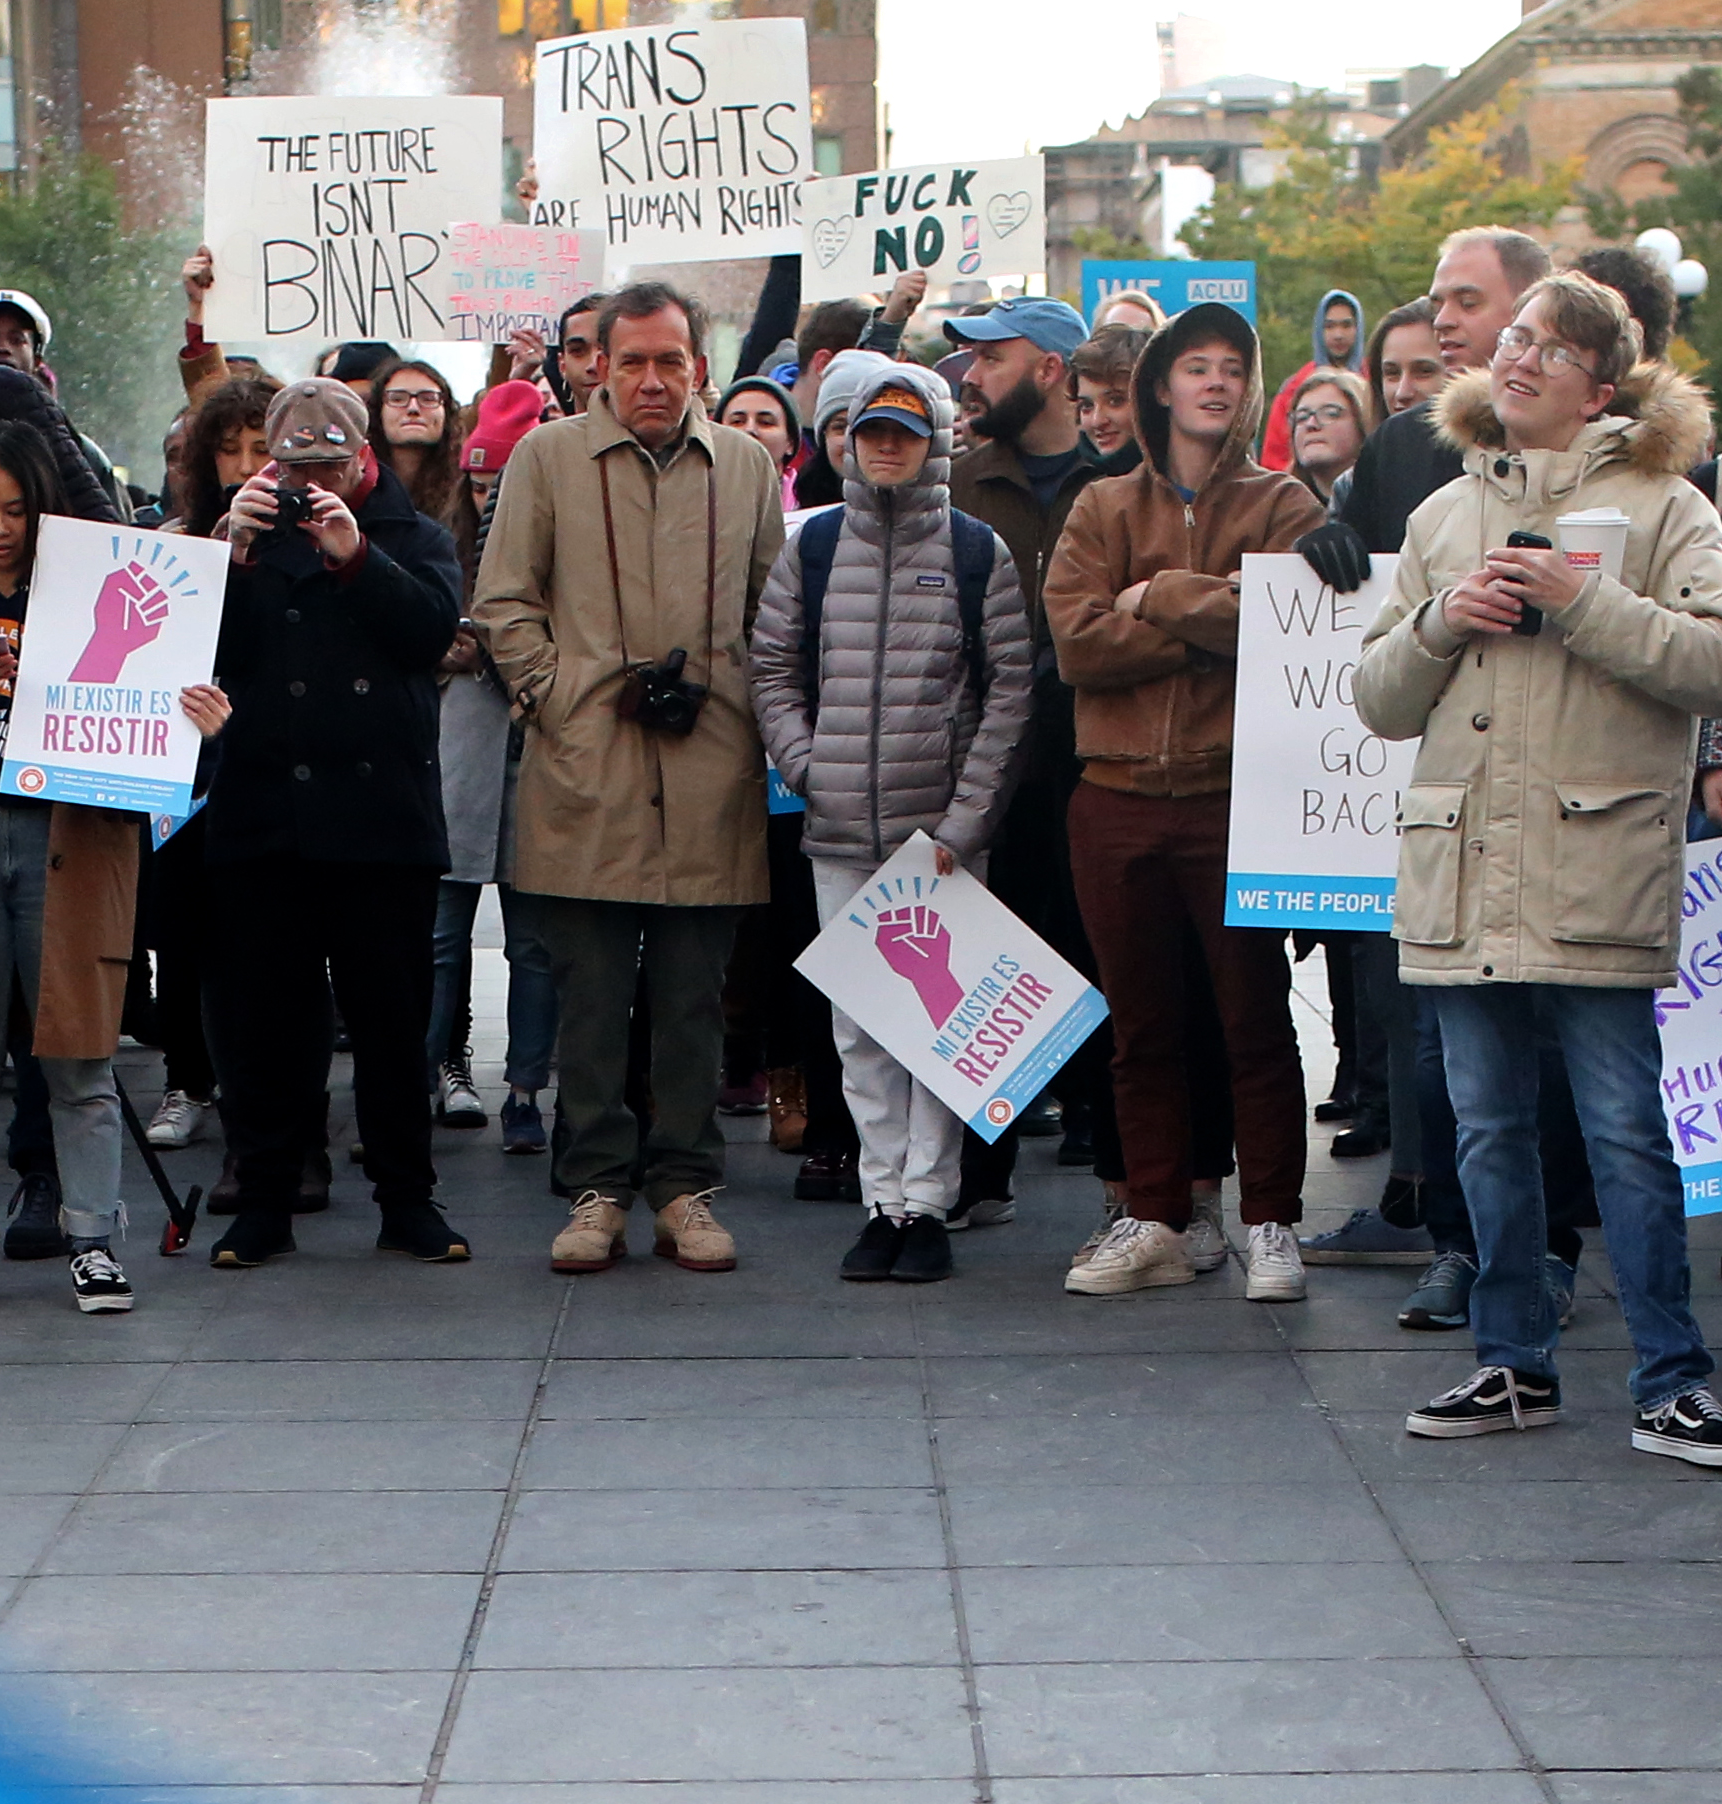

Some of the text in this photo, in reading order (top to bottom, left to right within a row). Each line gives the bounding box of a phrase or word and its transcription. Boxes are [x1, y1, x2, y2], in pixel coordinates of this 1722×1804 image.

[542, 31, 706, 112] TRANS
[257, 127, 438, 173] THE FUTURE
[597, 102, 799, 185] RIGHTS
[606, 188, 702, 245] HUMAN
[855, 169, 979, 218] FUCK
[263, 232, 449, 339] BINAR
[452, 271, 475, 290] TO
[484, 268, 536, 290] PROVE
[1191, 283, 1244, 299] ACLU
[449, 311, 562, 345] IMPORTAN
[1267, 581, 1364, 637] WE
[45, 685, 172, 715] MI EXISTIR ES
[42, 713, 170, 757] RESISTIR
[1320, 727, 1388, 778] GO
[1237, 890, 1271, 910] WE
[1274, 891, 1315, 912] THE
[931, 953, 1021, 1063] MI EXISTIR ES
[952, 972, 1054, 1088] RESISTIR
